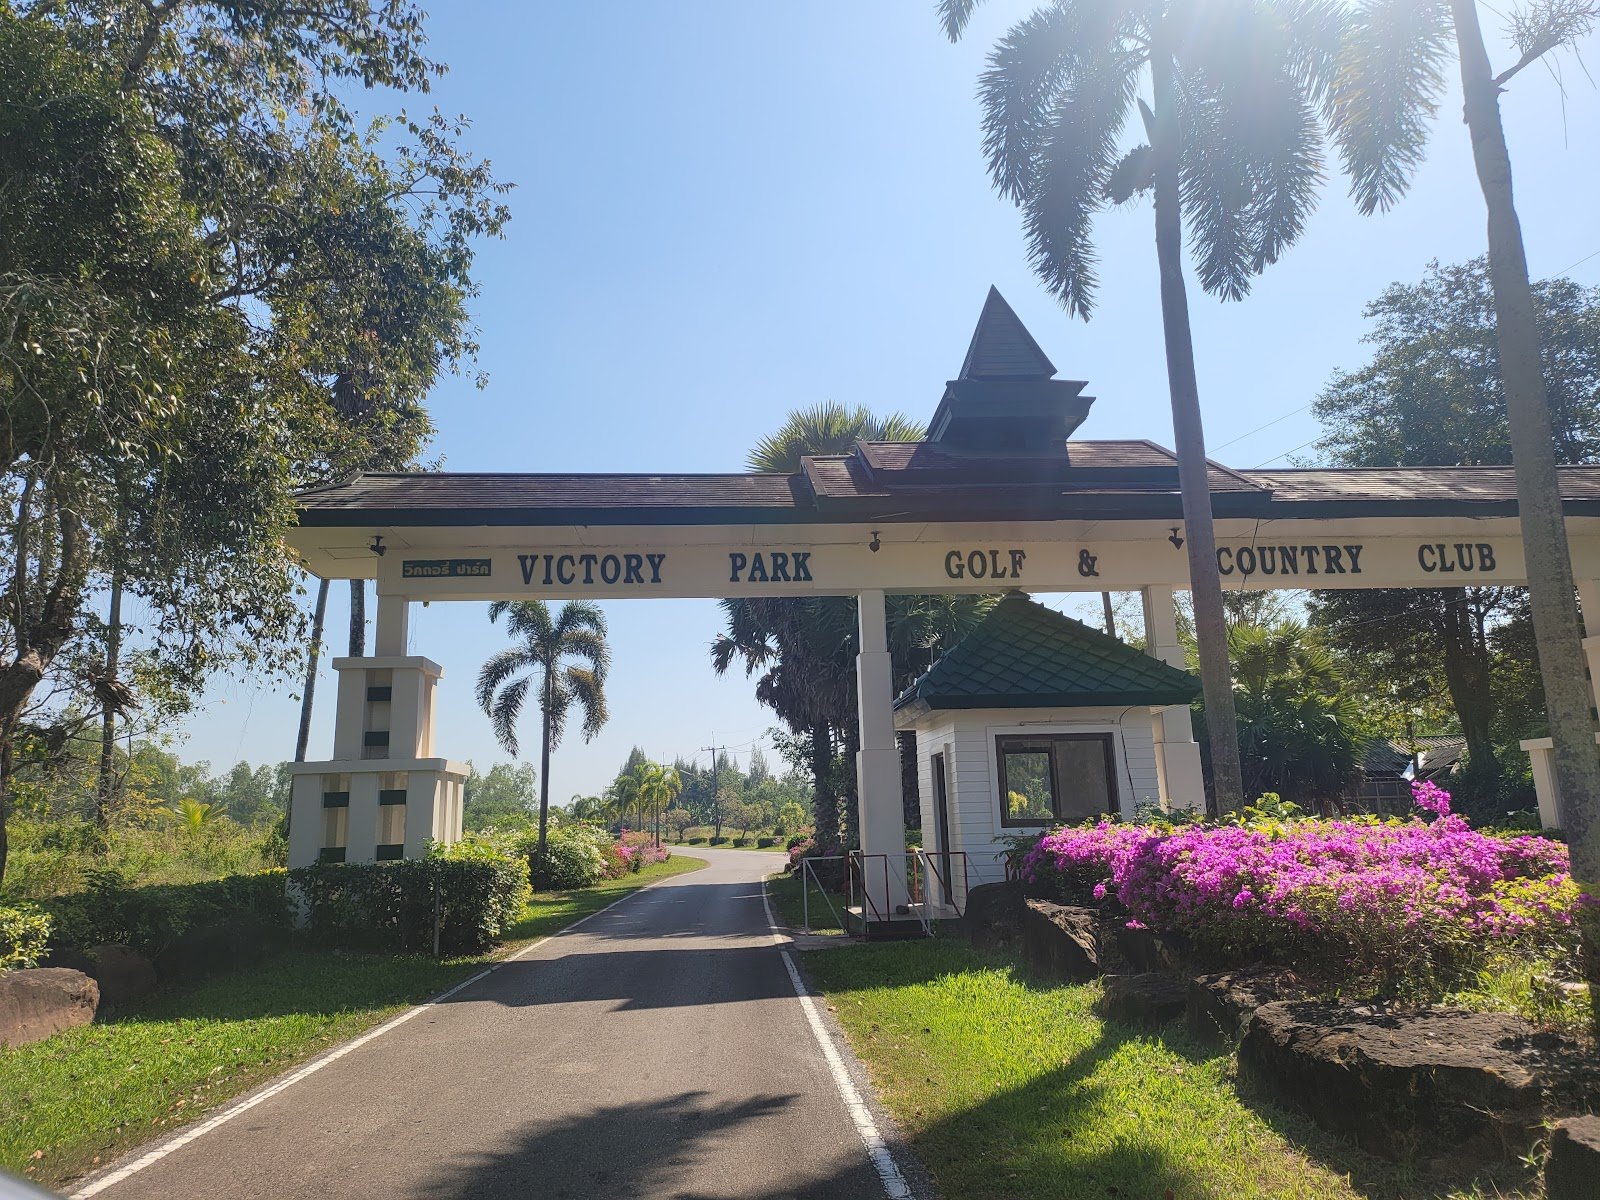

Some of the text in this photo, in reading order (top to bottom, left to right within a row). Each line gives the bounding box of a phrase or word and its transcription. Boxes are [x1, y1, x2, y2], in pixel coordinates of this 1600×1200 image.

[518, 544, 1496, 584] VICTORY PARK GOLF & COUNTRY CLUB
